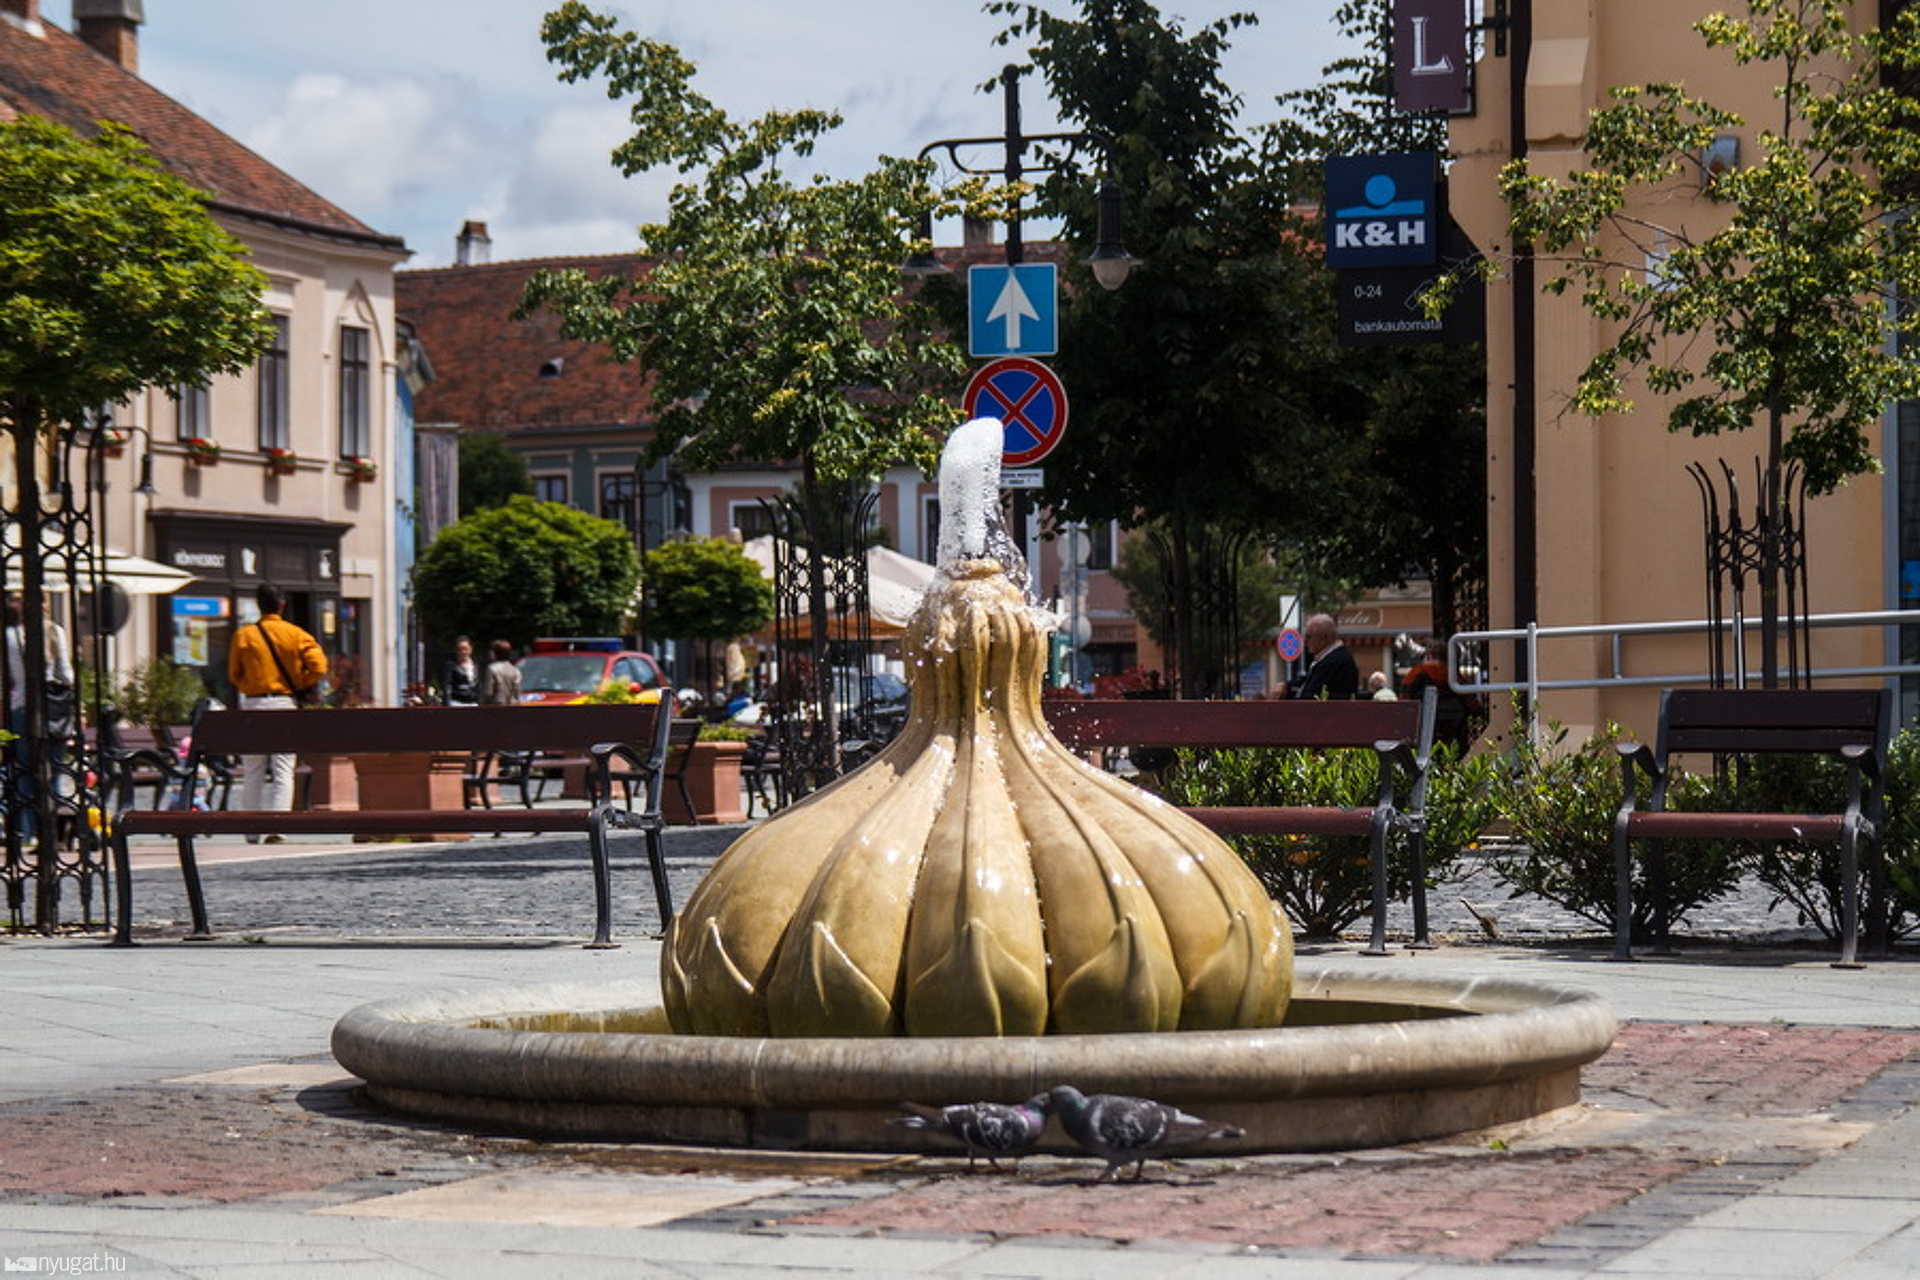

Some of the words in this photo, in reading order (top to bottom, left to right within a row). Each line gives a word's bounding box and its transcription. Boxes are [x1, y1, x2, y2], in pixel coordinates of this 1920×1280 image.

[1411, 17, 1453, 75] L
[1335, 220, 1425, 248] K&H
[1354, 285, 1382, 299] 0-24
